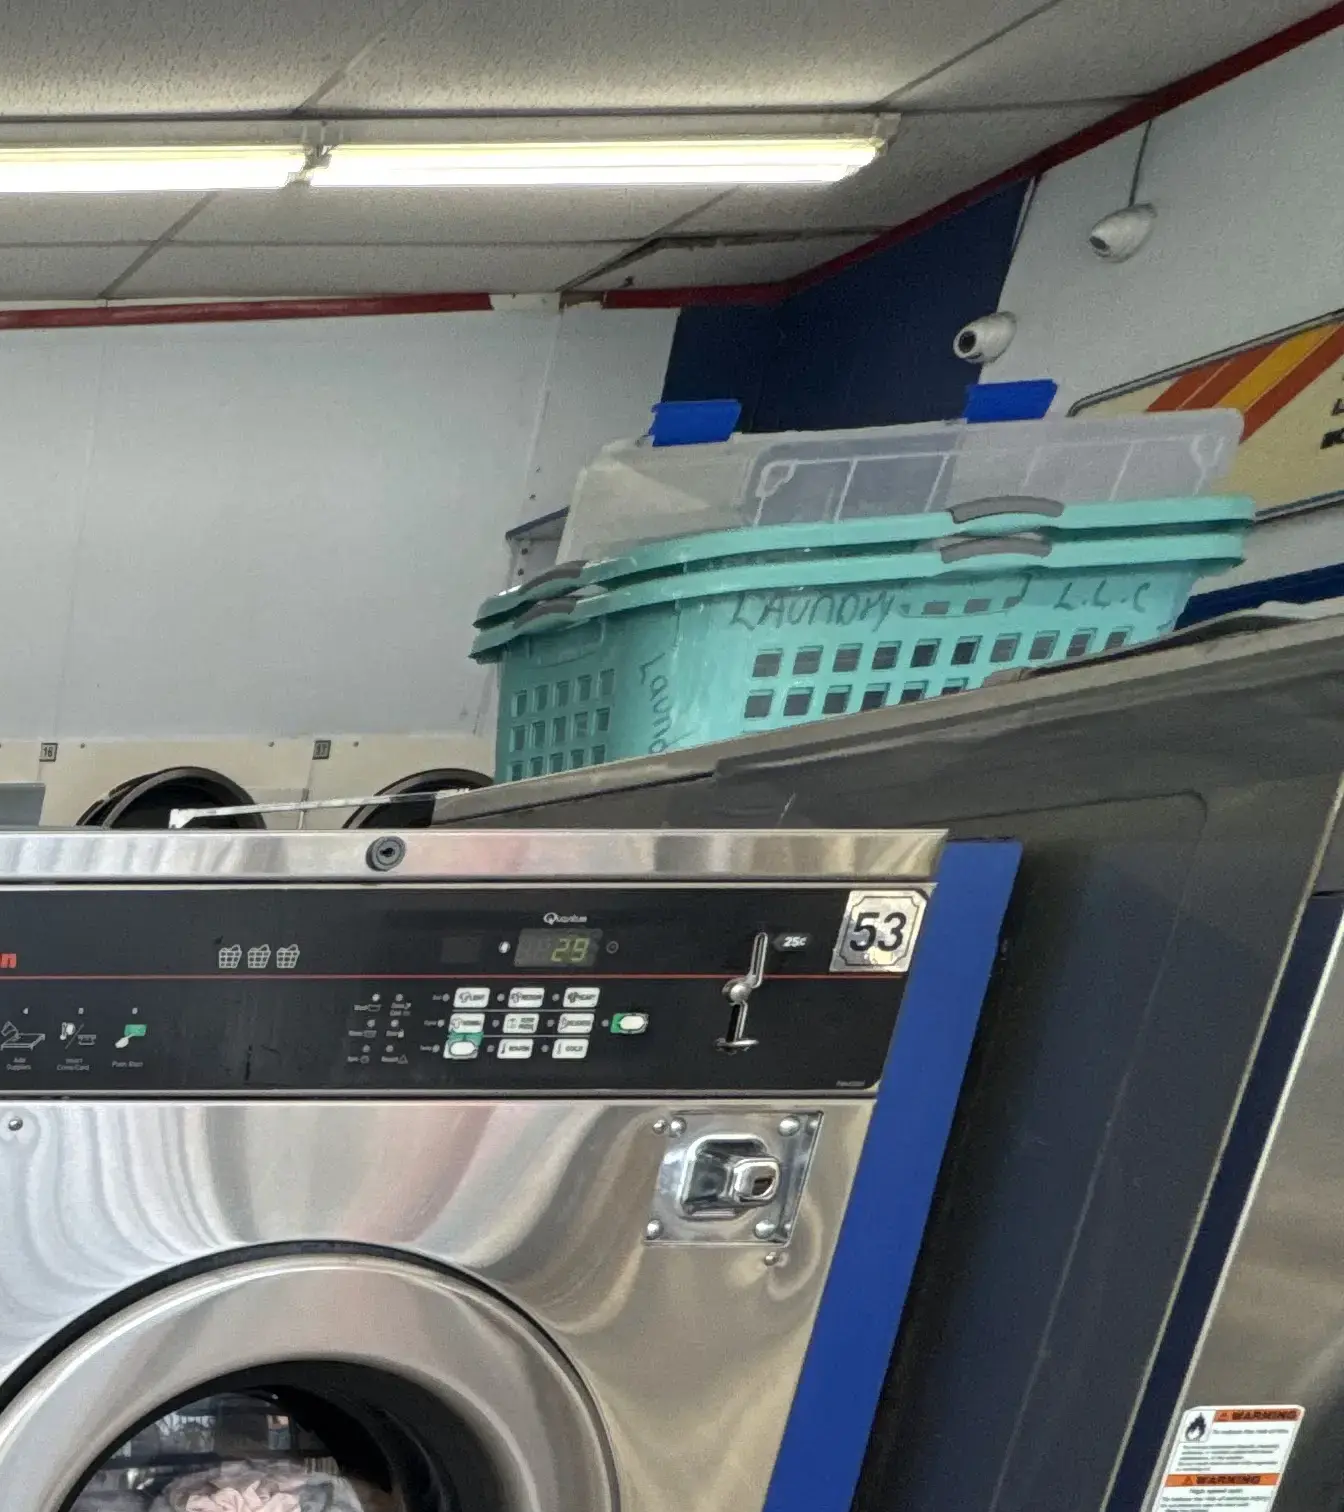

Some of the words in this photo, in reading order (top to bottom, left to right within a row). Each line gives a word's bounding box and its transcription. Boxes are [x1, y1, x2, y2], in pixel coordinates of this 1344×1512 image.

[849, 912, 908, 952] 53
[550, 936, 590, 962] 29
[1232, 1410, 1298, 1421] WARNING
[1195, 1475, 1261, 1485] WARNING
